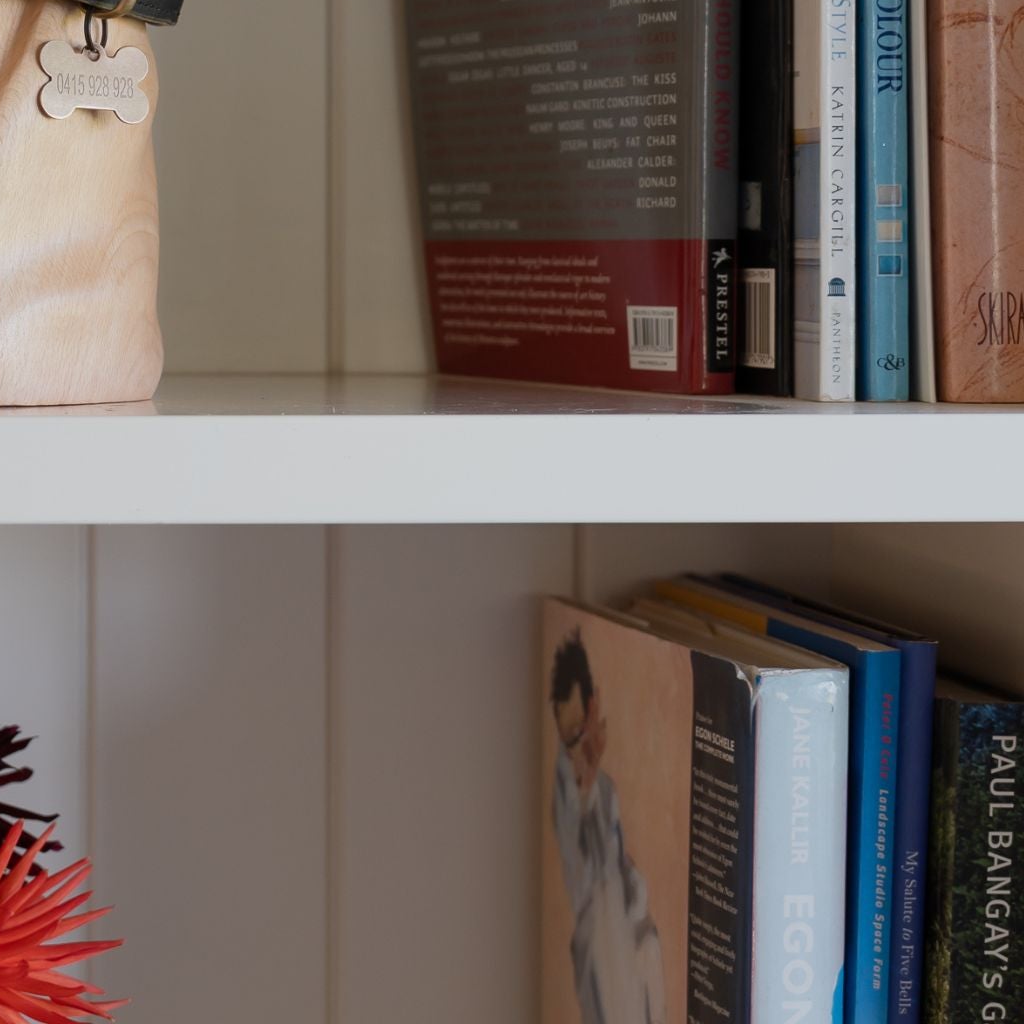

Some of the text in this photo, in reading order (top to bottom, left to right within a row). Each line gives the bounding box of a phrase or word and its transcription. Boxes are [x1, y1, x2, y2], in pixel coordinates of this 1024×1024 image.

[637, 11, 678, 27] JOHANN
[57, 73, 134, 98] 0415 928 928
[607, 93, 678, 109] CONSTRUCTION
[632, 74, 648, 86] THE
[653, 72, 677, 84] KISS
[619, 116, 638, 128] AND
[643, 114, 677, 129] QUEEN
[626, 136, 641, 148] FAT
[646, 134, 677, 147] CHAIR
[713, 90, 733, 171] KNOW
[831, 86, 844, 158] KATRIN
[636, 196, 677, 209] RICHARD
[638, 176, 677, 188] DONALD
[831, 169, 844, 257] CARGILL
[715, 273, 729, 361] PRESTEL
[977, 291, 1024, 346] SKIRA
[831, 312, 841, 384] PANTHEON
[877, 353, 905, 372] C&B
[988, 734, 1017, 817] PAUL
[875, 789, 889, 860] Landscape
[782, 706, 815, 1024] JANE KALLIR EGON
[875, 864, 886, 908] Studio
[982, 831, 1014, 989] BANGAY'S
[872, 913, 886, 953] Space
[898, 851, 919, 1015] My Salute to Five Bells
[872, 958, 884, 990] Form
